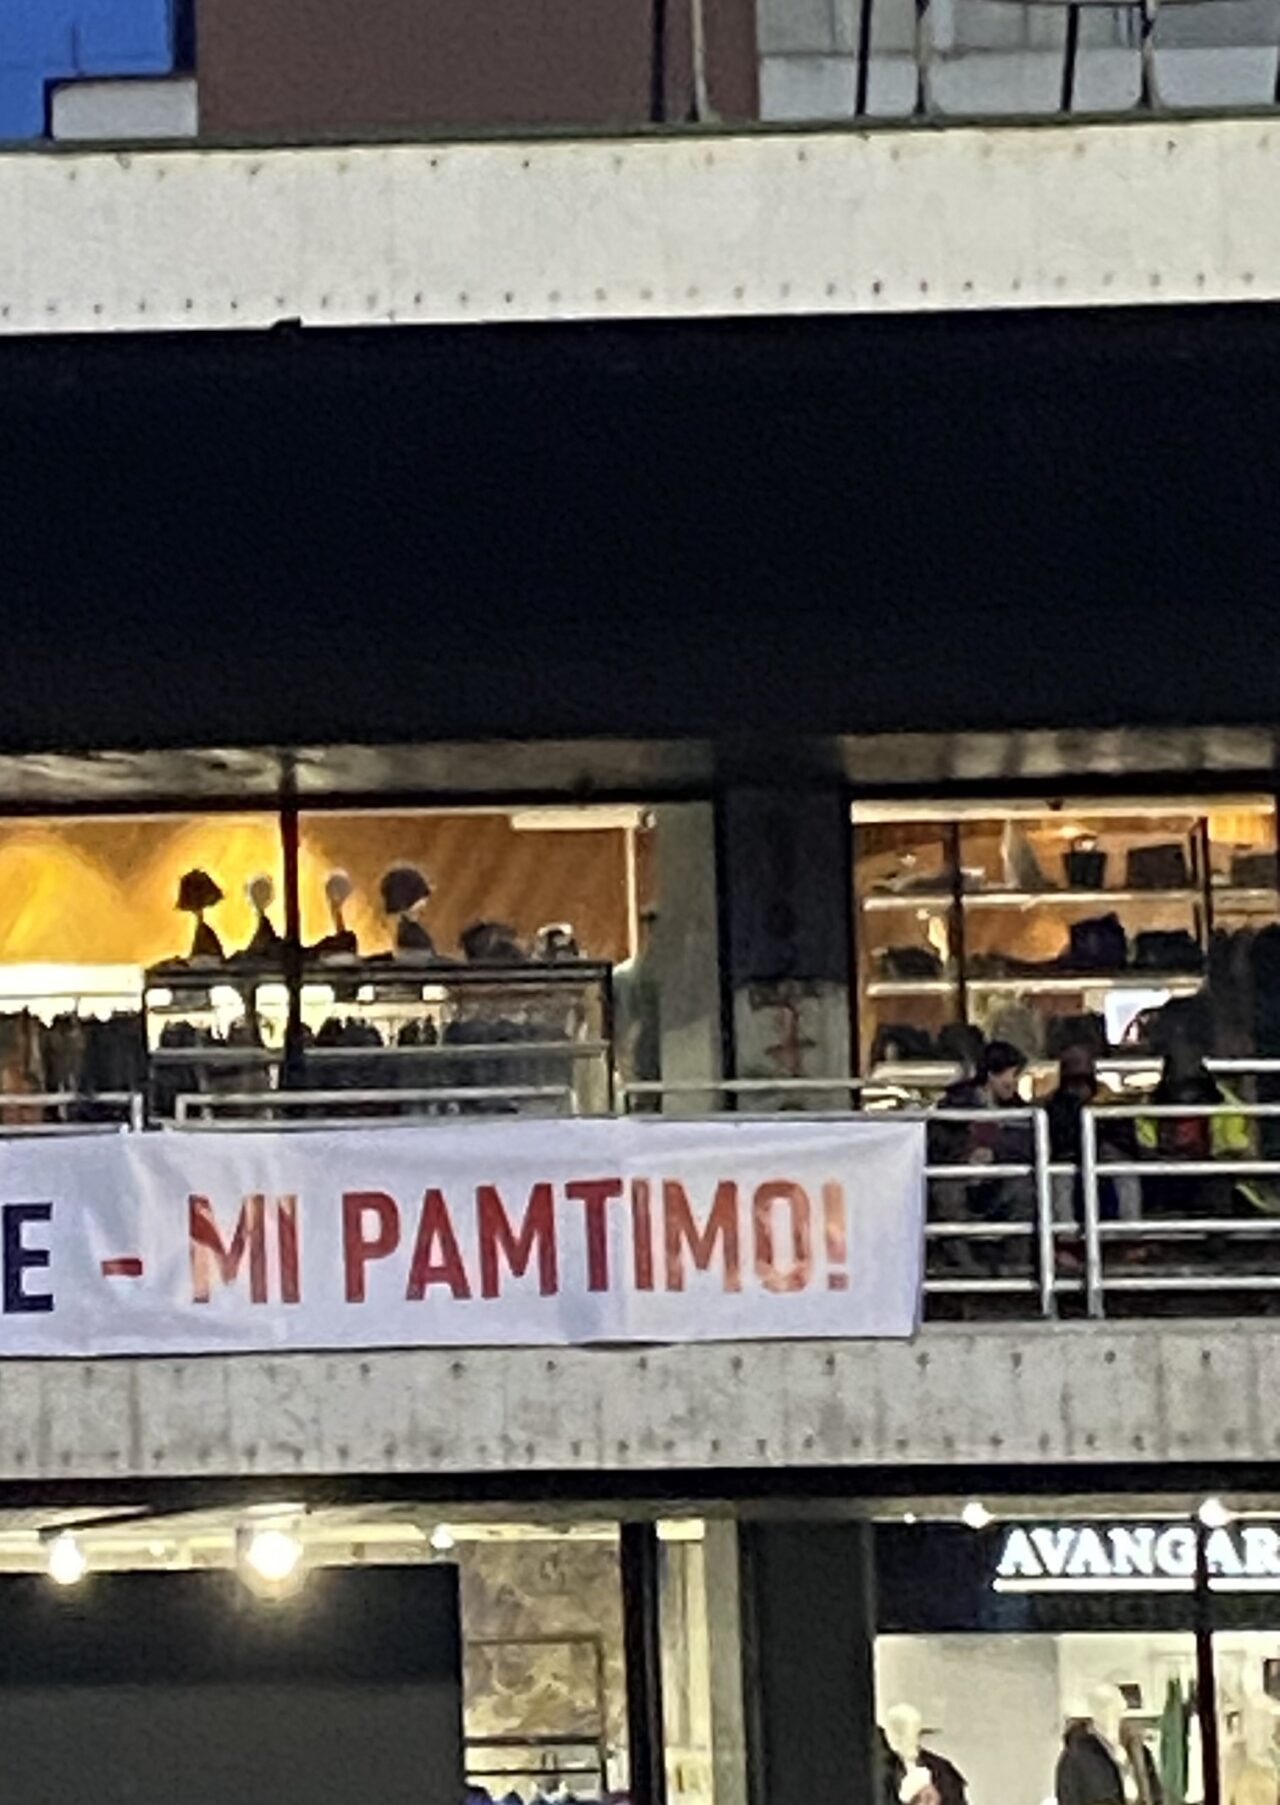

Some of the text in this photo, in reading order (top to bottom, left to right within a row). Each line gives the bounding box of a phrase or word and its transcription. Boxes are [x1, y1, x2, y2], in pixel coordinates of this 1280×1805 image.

[189, 1193, 300, 1303] MI
[342, 1177, 848, 1303] PAMTIMO!
[996, 1528, 1280, 1576] AVANGAR
